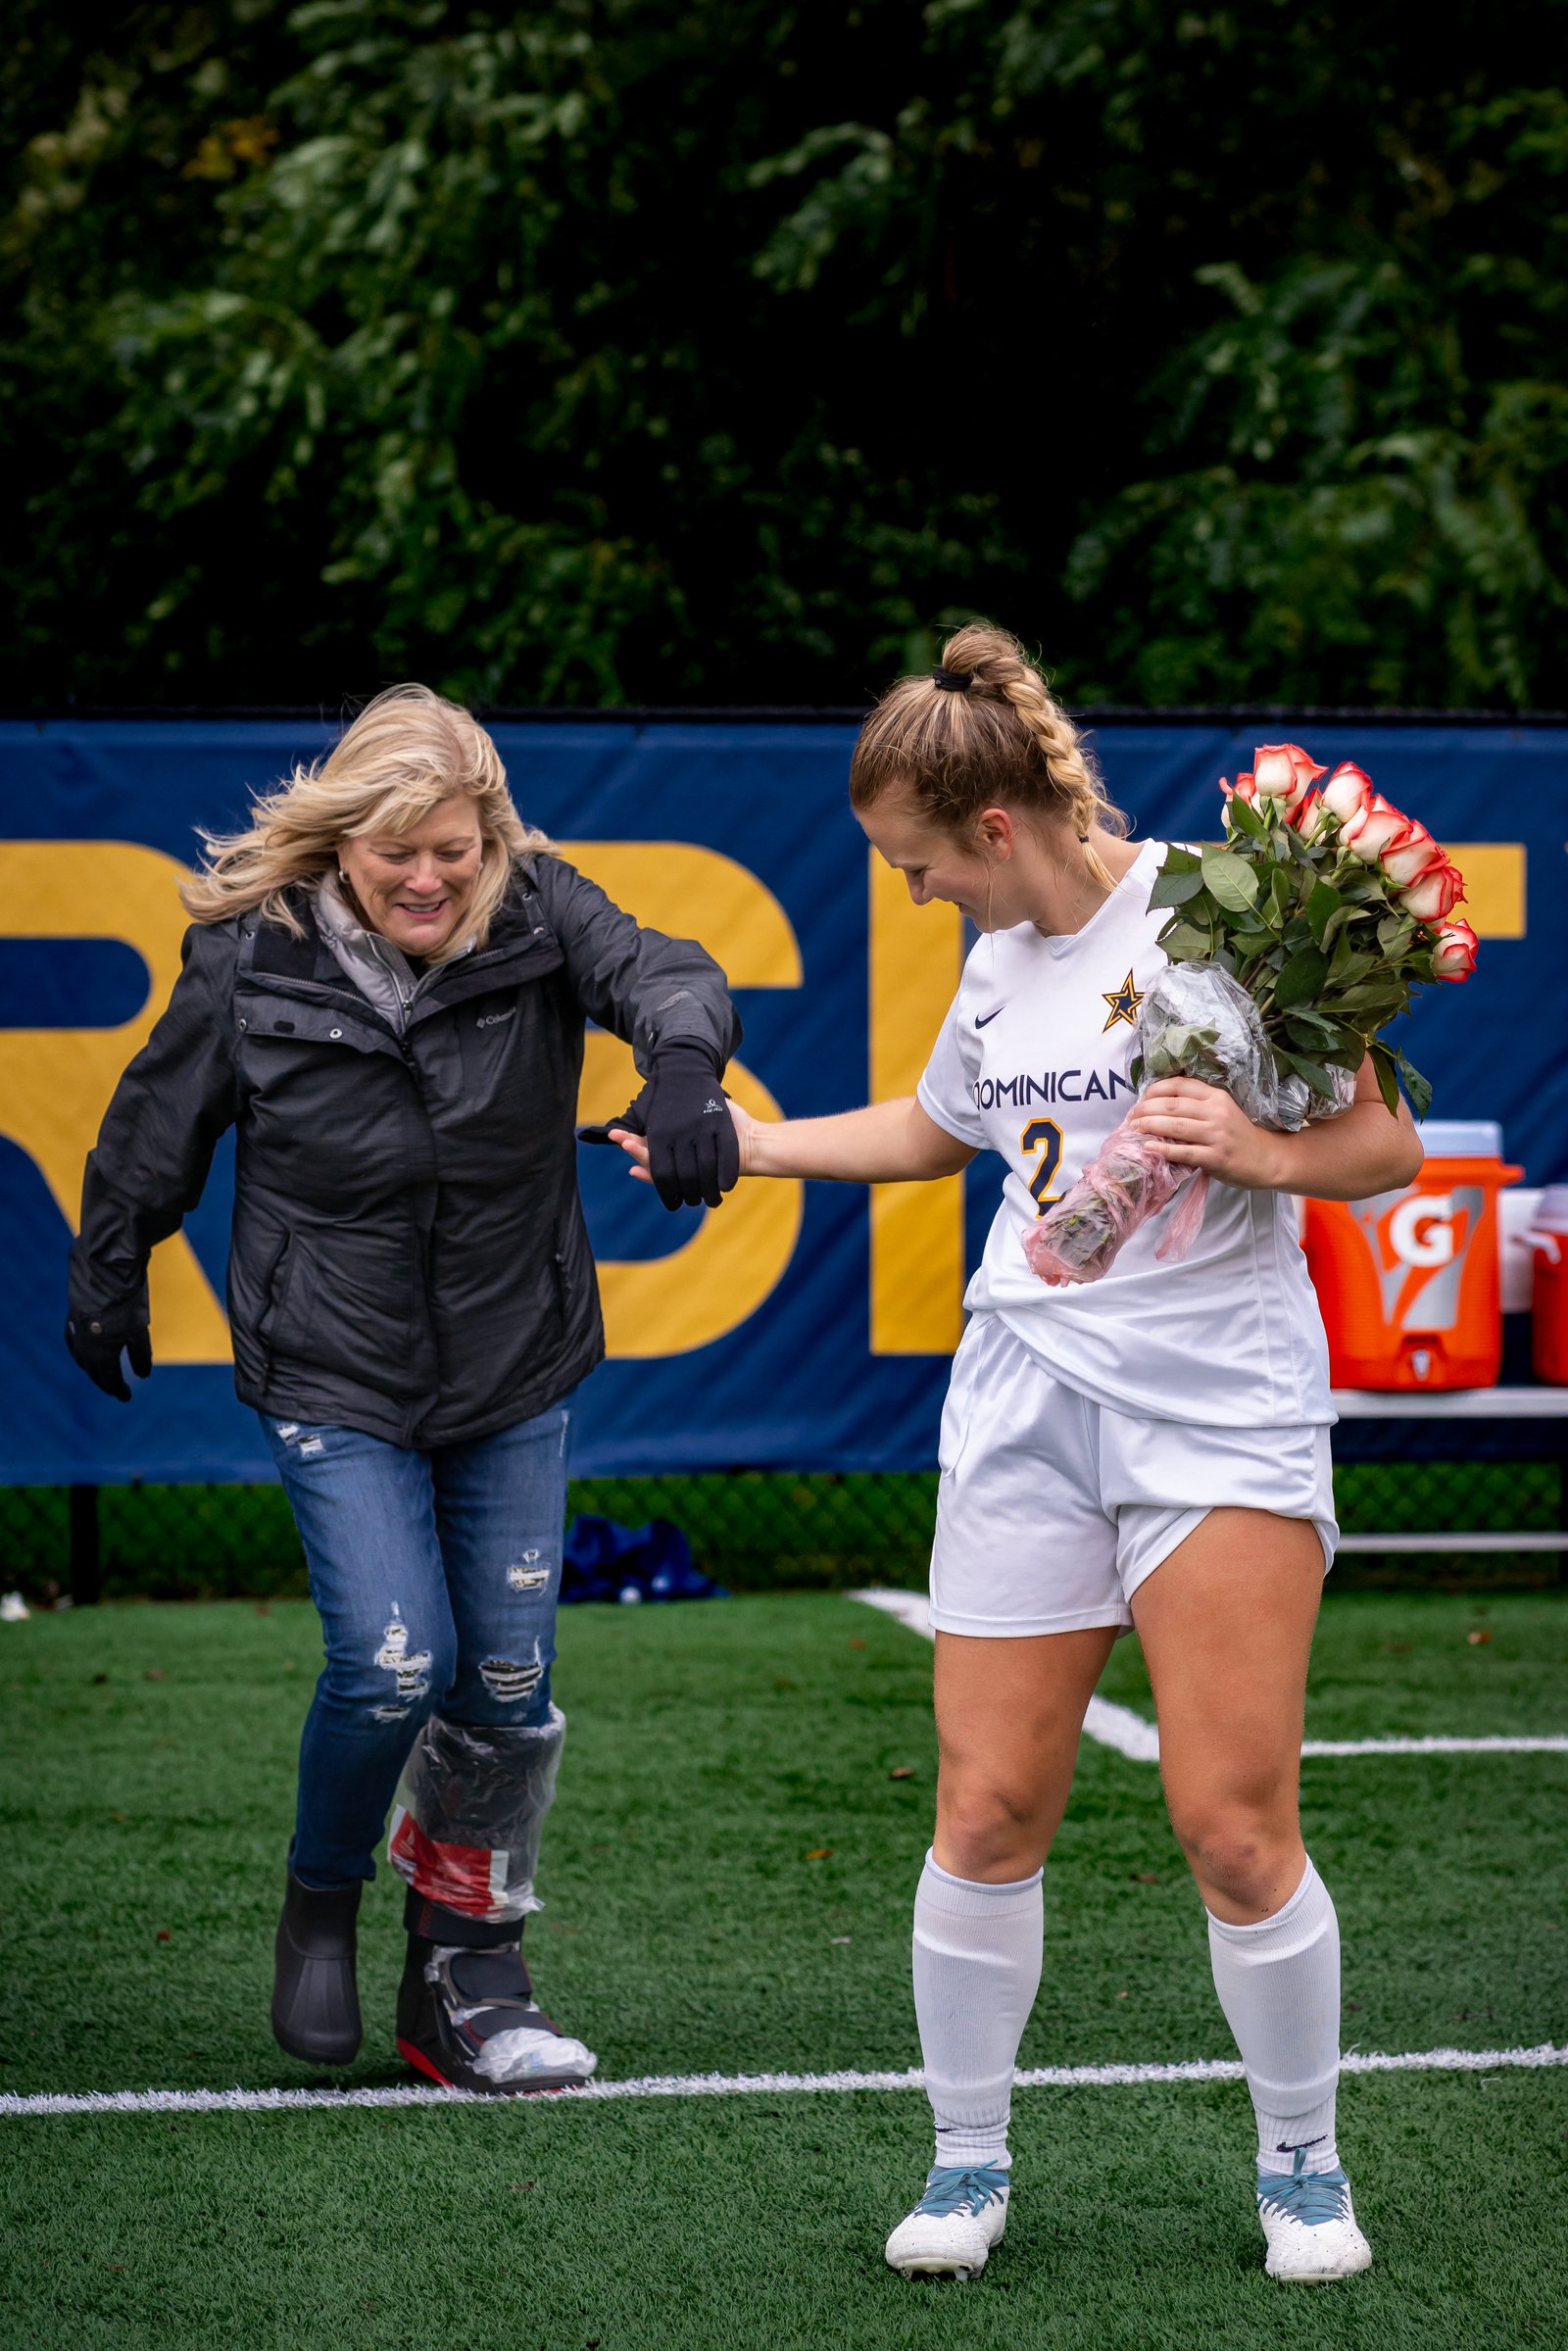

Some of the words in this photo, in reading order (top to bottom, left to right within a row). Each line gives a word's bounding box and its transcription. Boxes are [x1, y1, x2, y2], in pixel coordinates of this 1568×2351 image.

[973, 1068, 1139, 1110] DOMINICAN
[1020, 1117, 1065, 1219] 2
[1389, 1194, 1454, 1267] G
